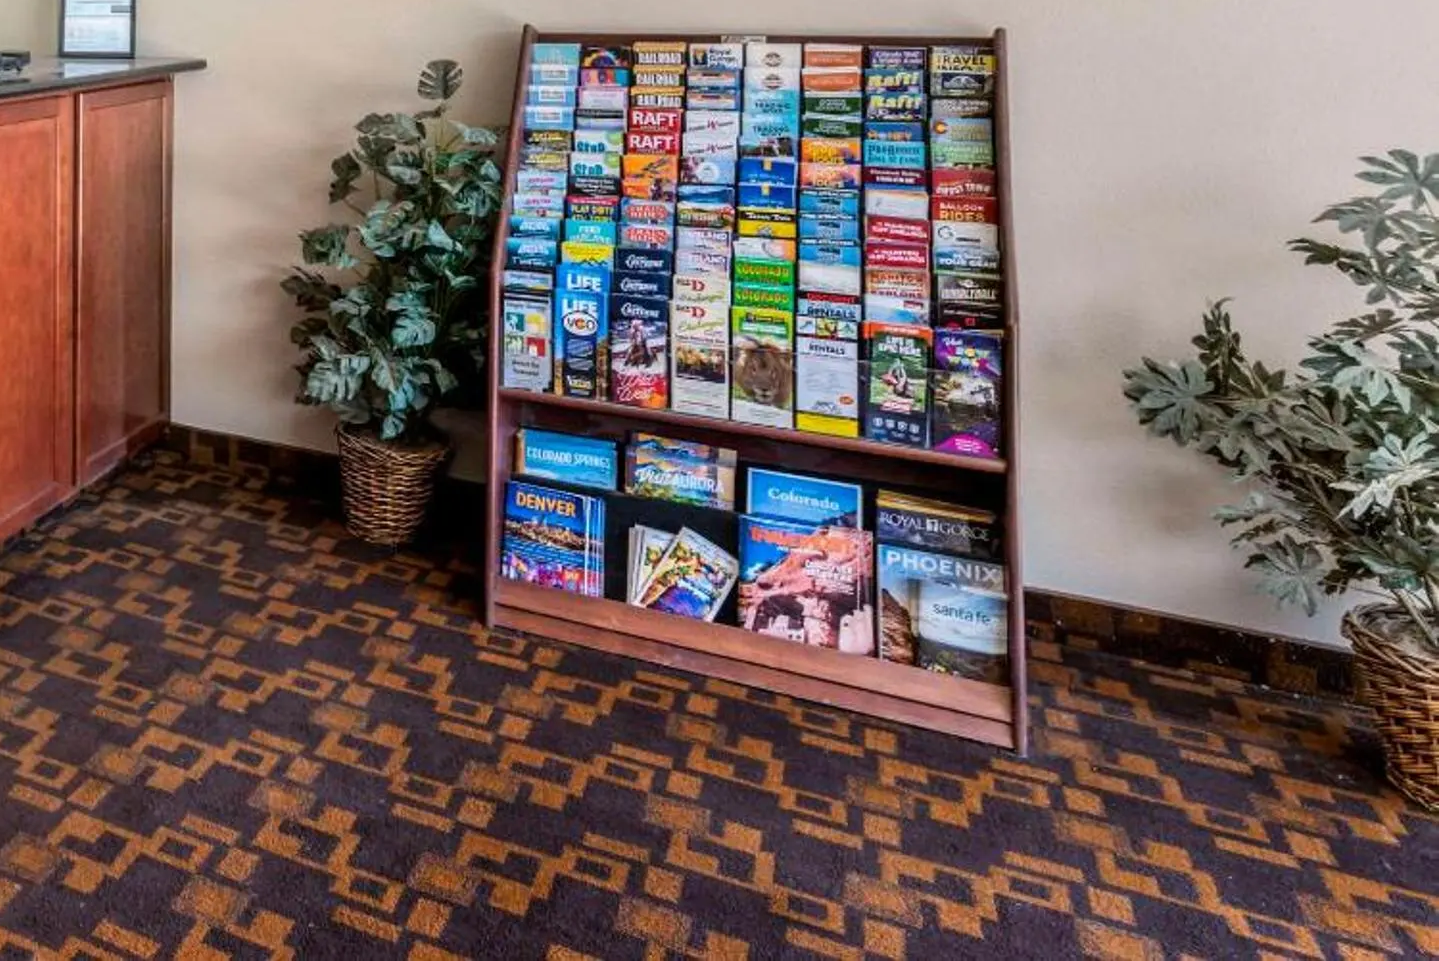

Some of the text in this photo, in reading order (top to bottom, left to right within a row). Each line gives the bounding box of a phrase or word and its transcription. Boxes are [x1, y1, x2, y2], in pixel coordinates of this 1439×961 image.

[632, 111, 677, 127] RAFT
[629, 135, 674, 151] RAFT
[566, 272, 602, 292] LIFE
[562, 298, 598, 314] LIFE
[807, 306, 856, 318] RENTALS
[809, 343, 846, 355] RENTALS
[526, 445, 610, 470] COLORADO SPRINGS
[673, 474, 726, 494] AURORA
[515, 490, 577, 519] DENVER
[767, 486, 841, 511] Colorado
[879, 511, 991, 542] ROYAL GORGE
[886, 550, 1000, 584] PHOENIX
[932, 602, 991, 625] santa fe
